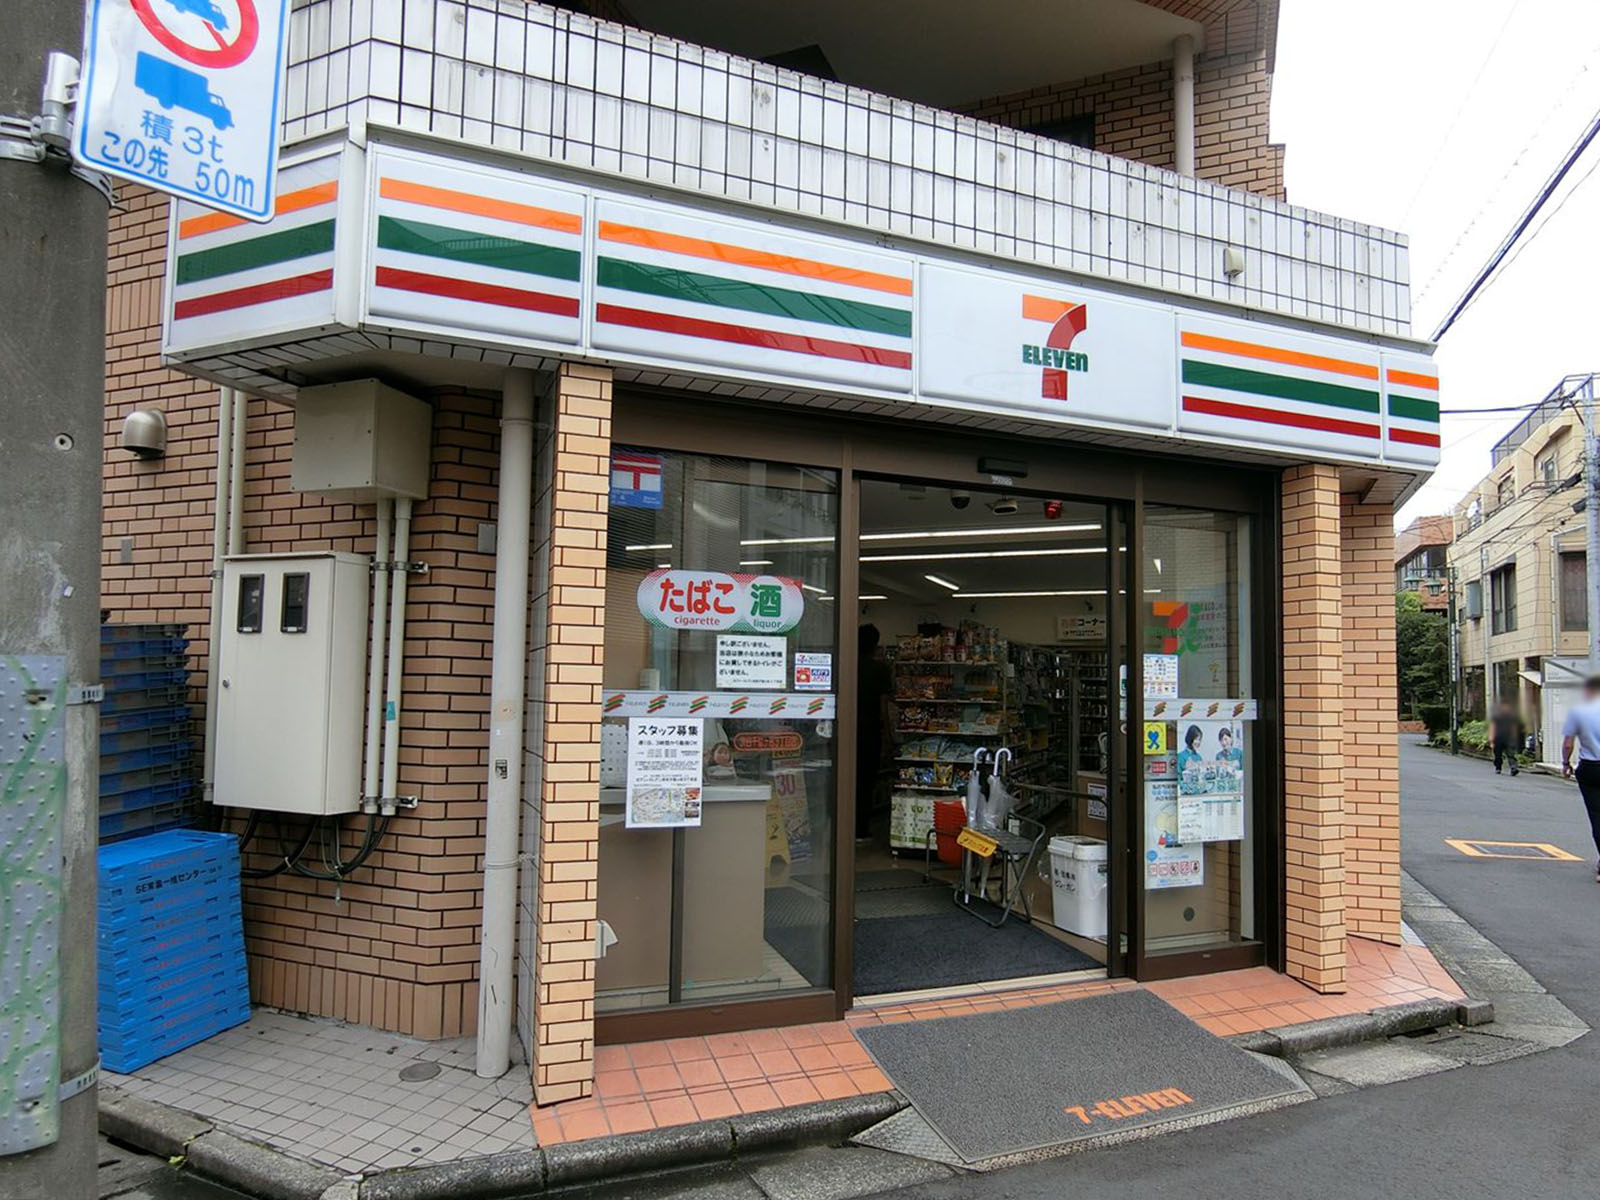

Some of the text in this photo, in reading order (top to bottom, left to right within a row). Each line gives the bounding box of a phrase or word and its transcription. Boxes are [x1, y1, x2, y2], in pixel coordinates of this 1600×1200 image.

[140, 109, 224, 164] 積 3t
[101, 130, 254, 208] この先 50m
[659, 578, 782, 618] たばこ 酒
[674, 615, 782, 630] cigarette liquor
[638, 725, 698, 736] スタッフ募集
